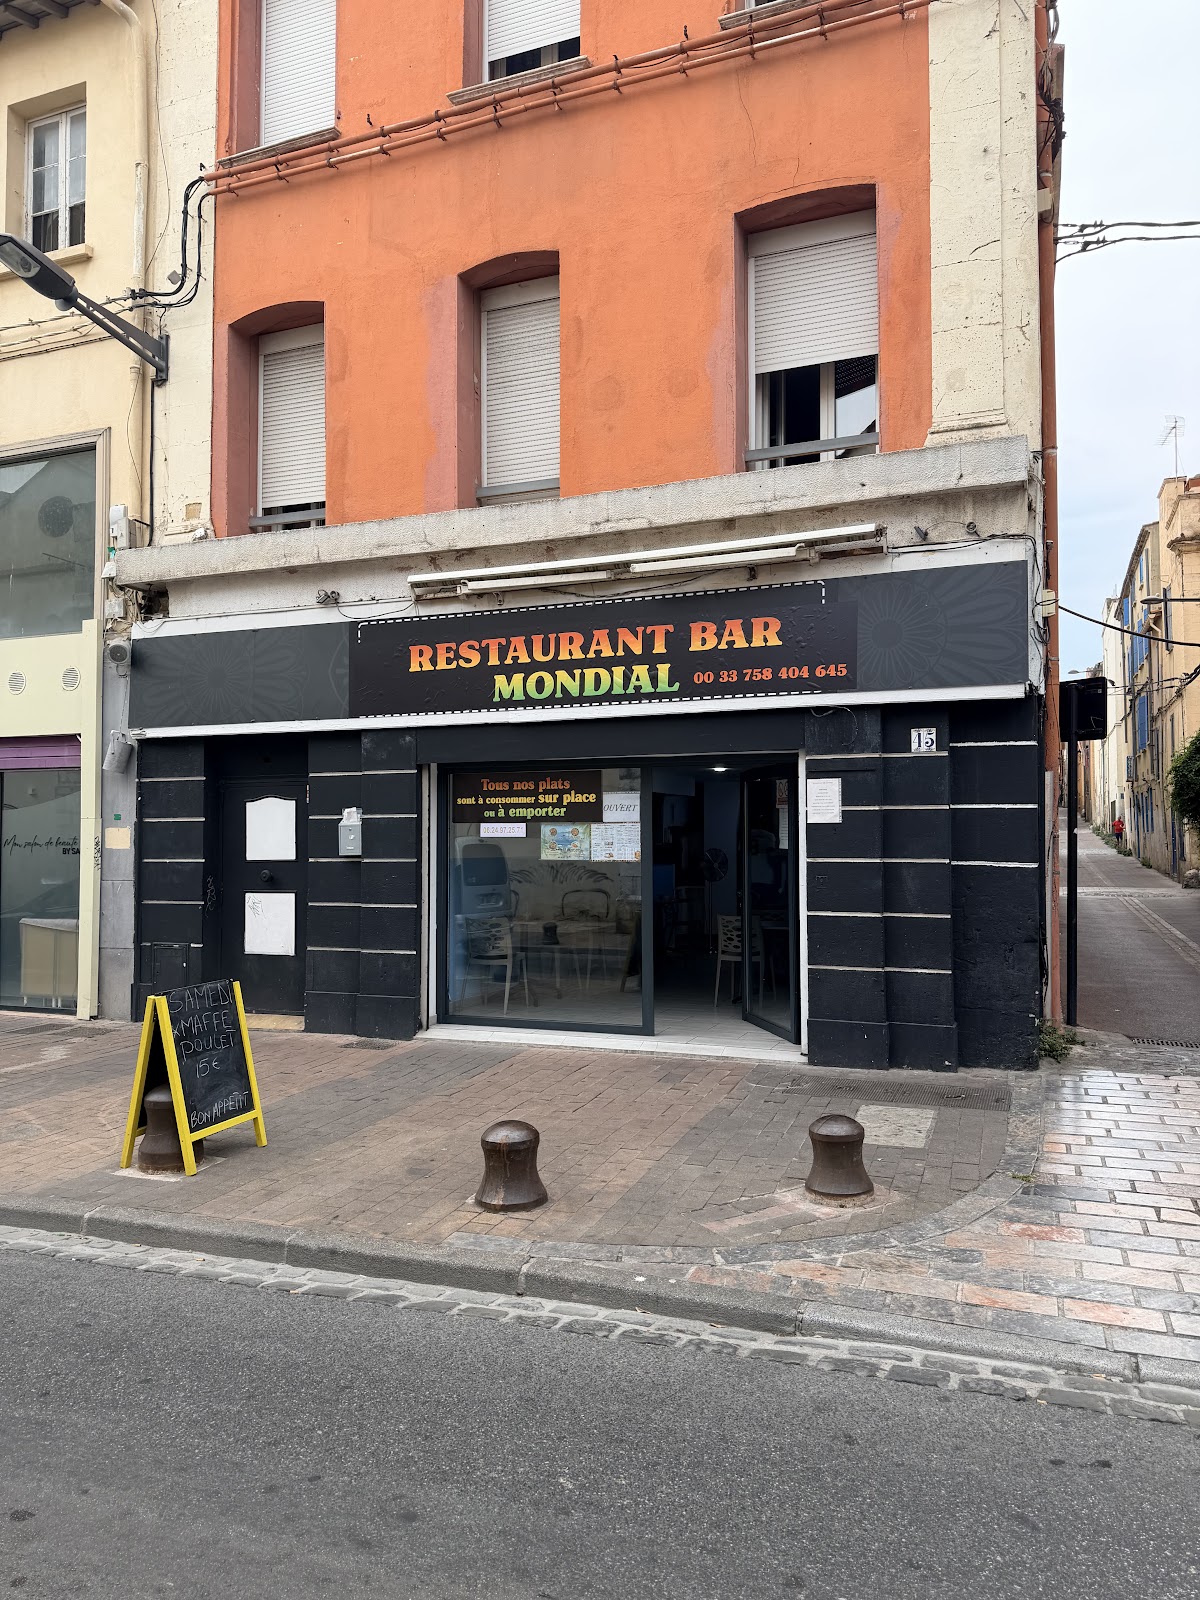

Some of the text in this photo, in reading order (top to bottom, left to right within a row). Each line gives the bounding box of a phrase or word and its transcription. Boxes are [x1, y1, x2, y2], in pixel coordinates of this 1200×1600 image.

[408, 616, 783, 672] RESTAURANT BAR
[492, 663, 680, 702] MONDIAL
[693, 663, 848, 685] 00 33 758 404 645
[480, 777, 571, 793] Tous nos plats
[456, 789, 597, 806] sont à consommer sur place
[483, 804, 567, 820] ou à emporter
[603, 803, 639, 812] OUVERT
[3, 834, 22, 856] Mon
[23, 834, 43, 853] salon
[44, 836, 54, 851] de
[62, 847, 71, 855] BY
[179, 1029, 236, 1062] POULET
[190, 1110, 211, 1128] BON
